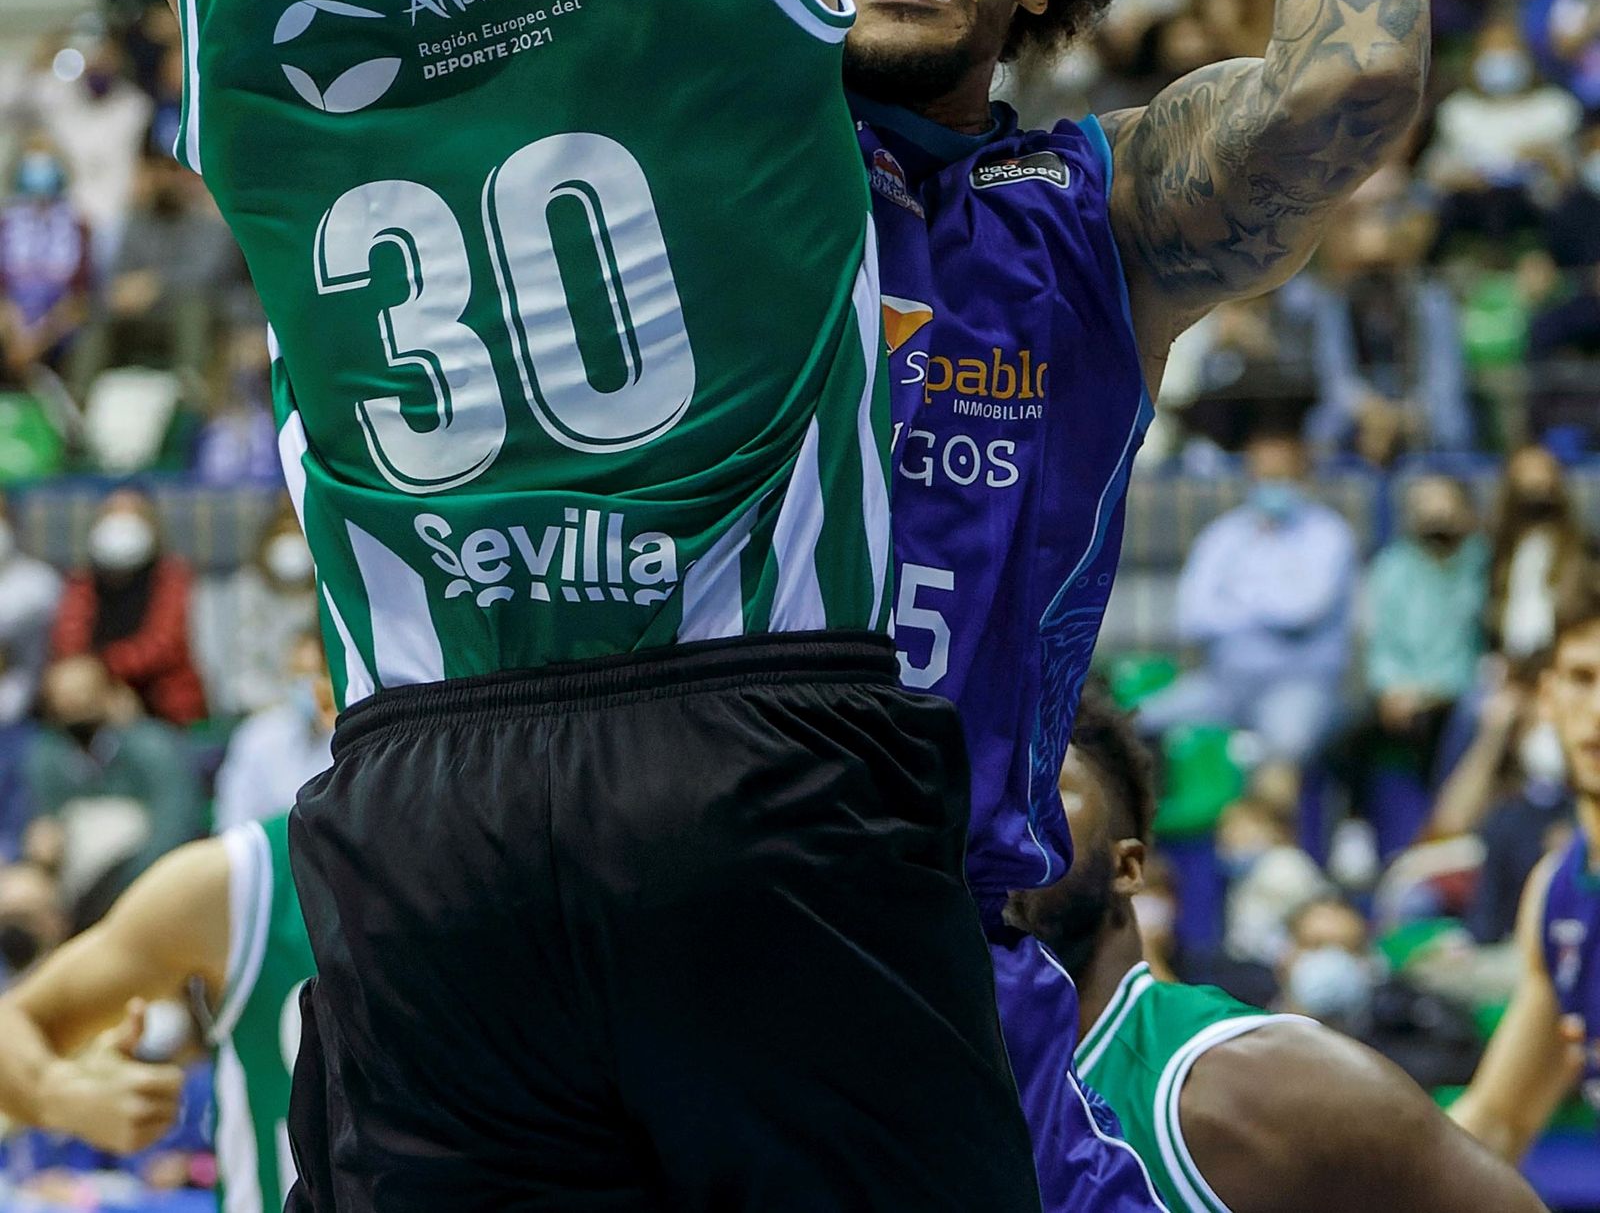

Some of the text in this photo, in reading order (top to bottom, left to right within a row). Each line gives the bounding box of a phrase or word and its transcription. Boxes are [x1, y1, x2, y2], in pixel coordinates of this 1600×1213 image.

[418, 31, 478, 58] Región
[481, 9, 547, 38] Europea
[423, 27, 553, 80] DEPORTE 2021
[980, 168, 1063, 182] endesa
[313, 132, 696, 494] 30
[890, 422, 1019, 487] GOS
[413, 507, 679, 585] Sevilla
[887, 563, 955, 689] 5
